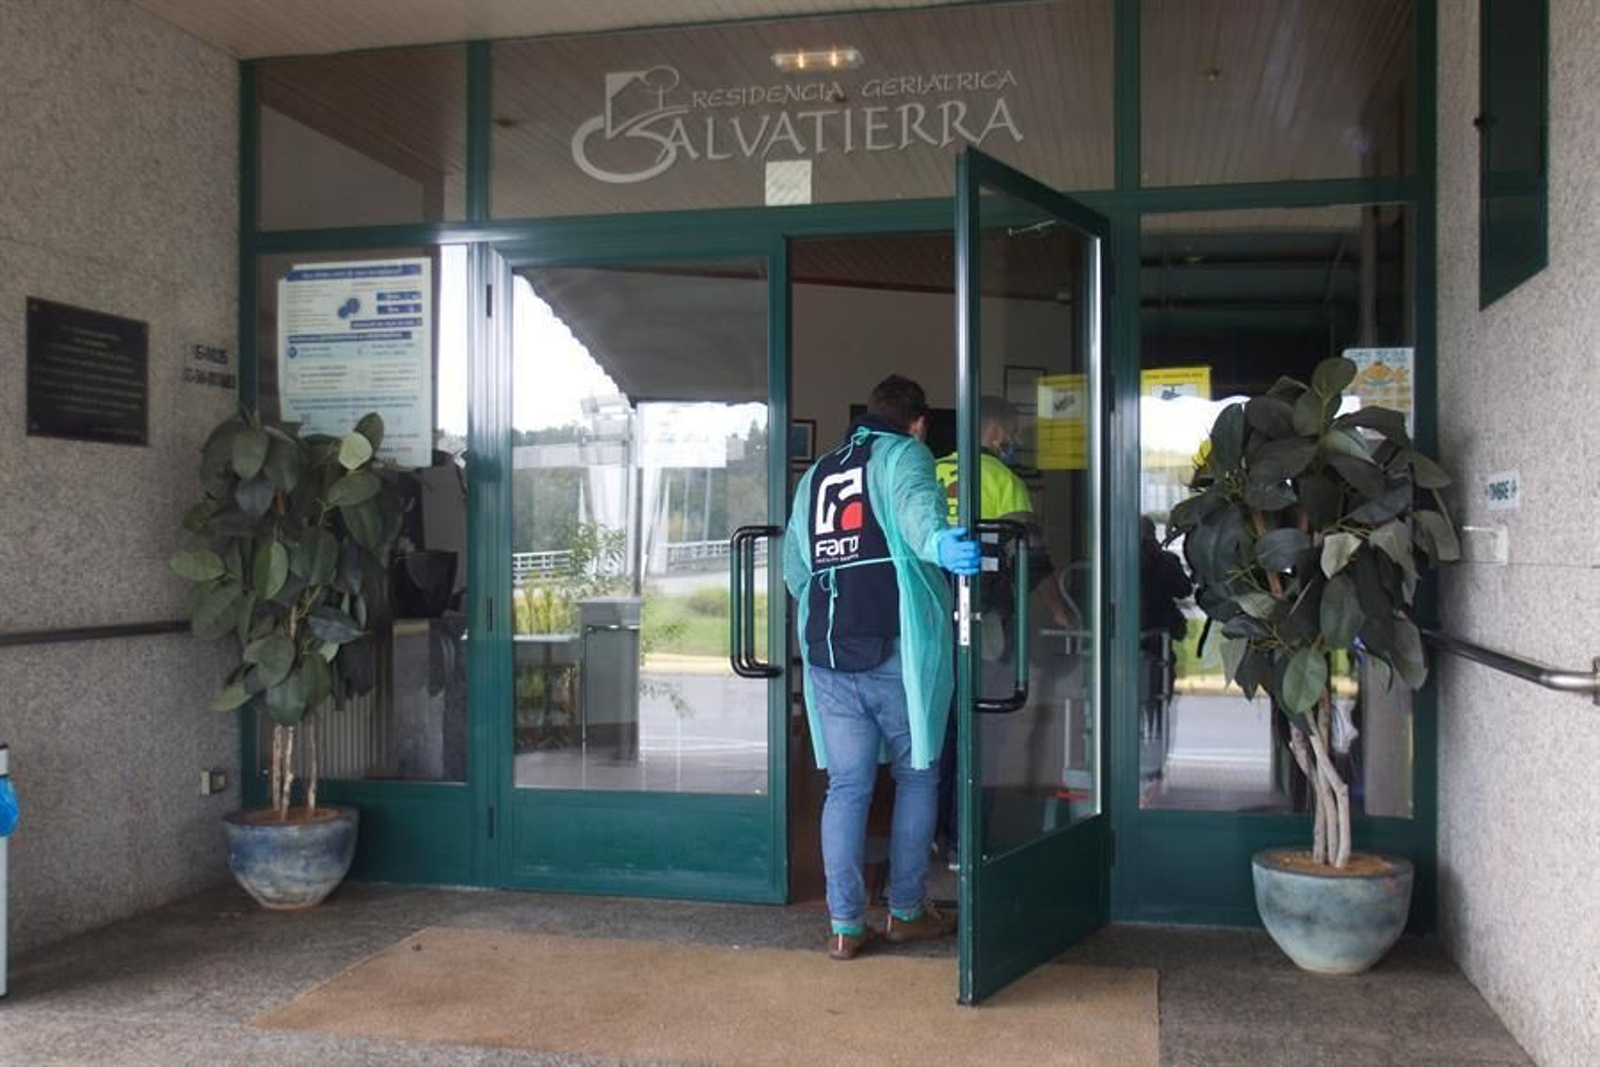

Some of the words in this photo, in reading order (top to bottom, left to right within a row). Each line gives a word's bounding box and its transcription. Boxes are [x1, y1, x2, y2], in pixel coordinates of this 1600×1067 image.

[691, 80, 844, 109] RESIDENCIA
[861, 70, 1018, 98] GERIATRICA
[571, 97, 1025, 184] SALVATIERRA
